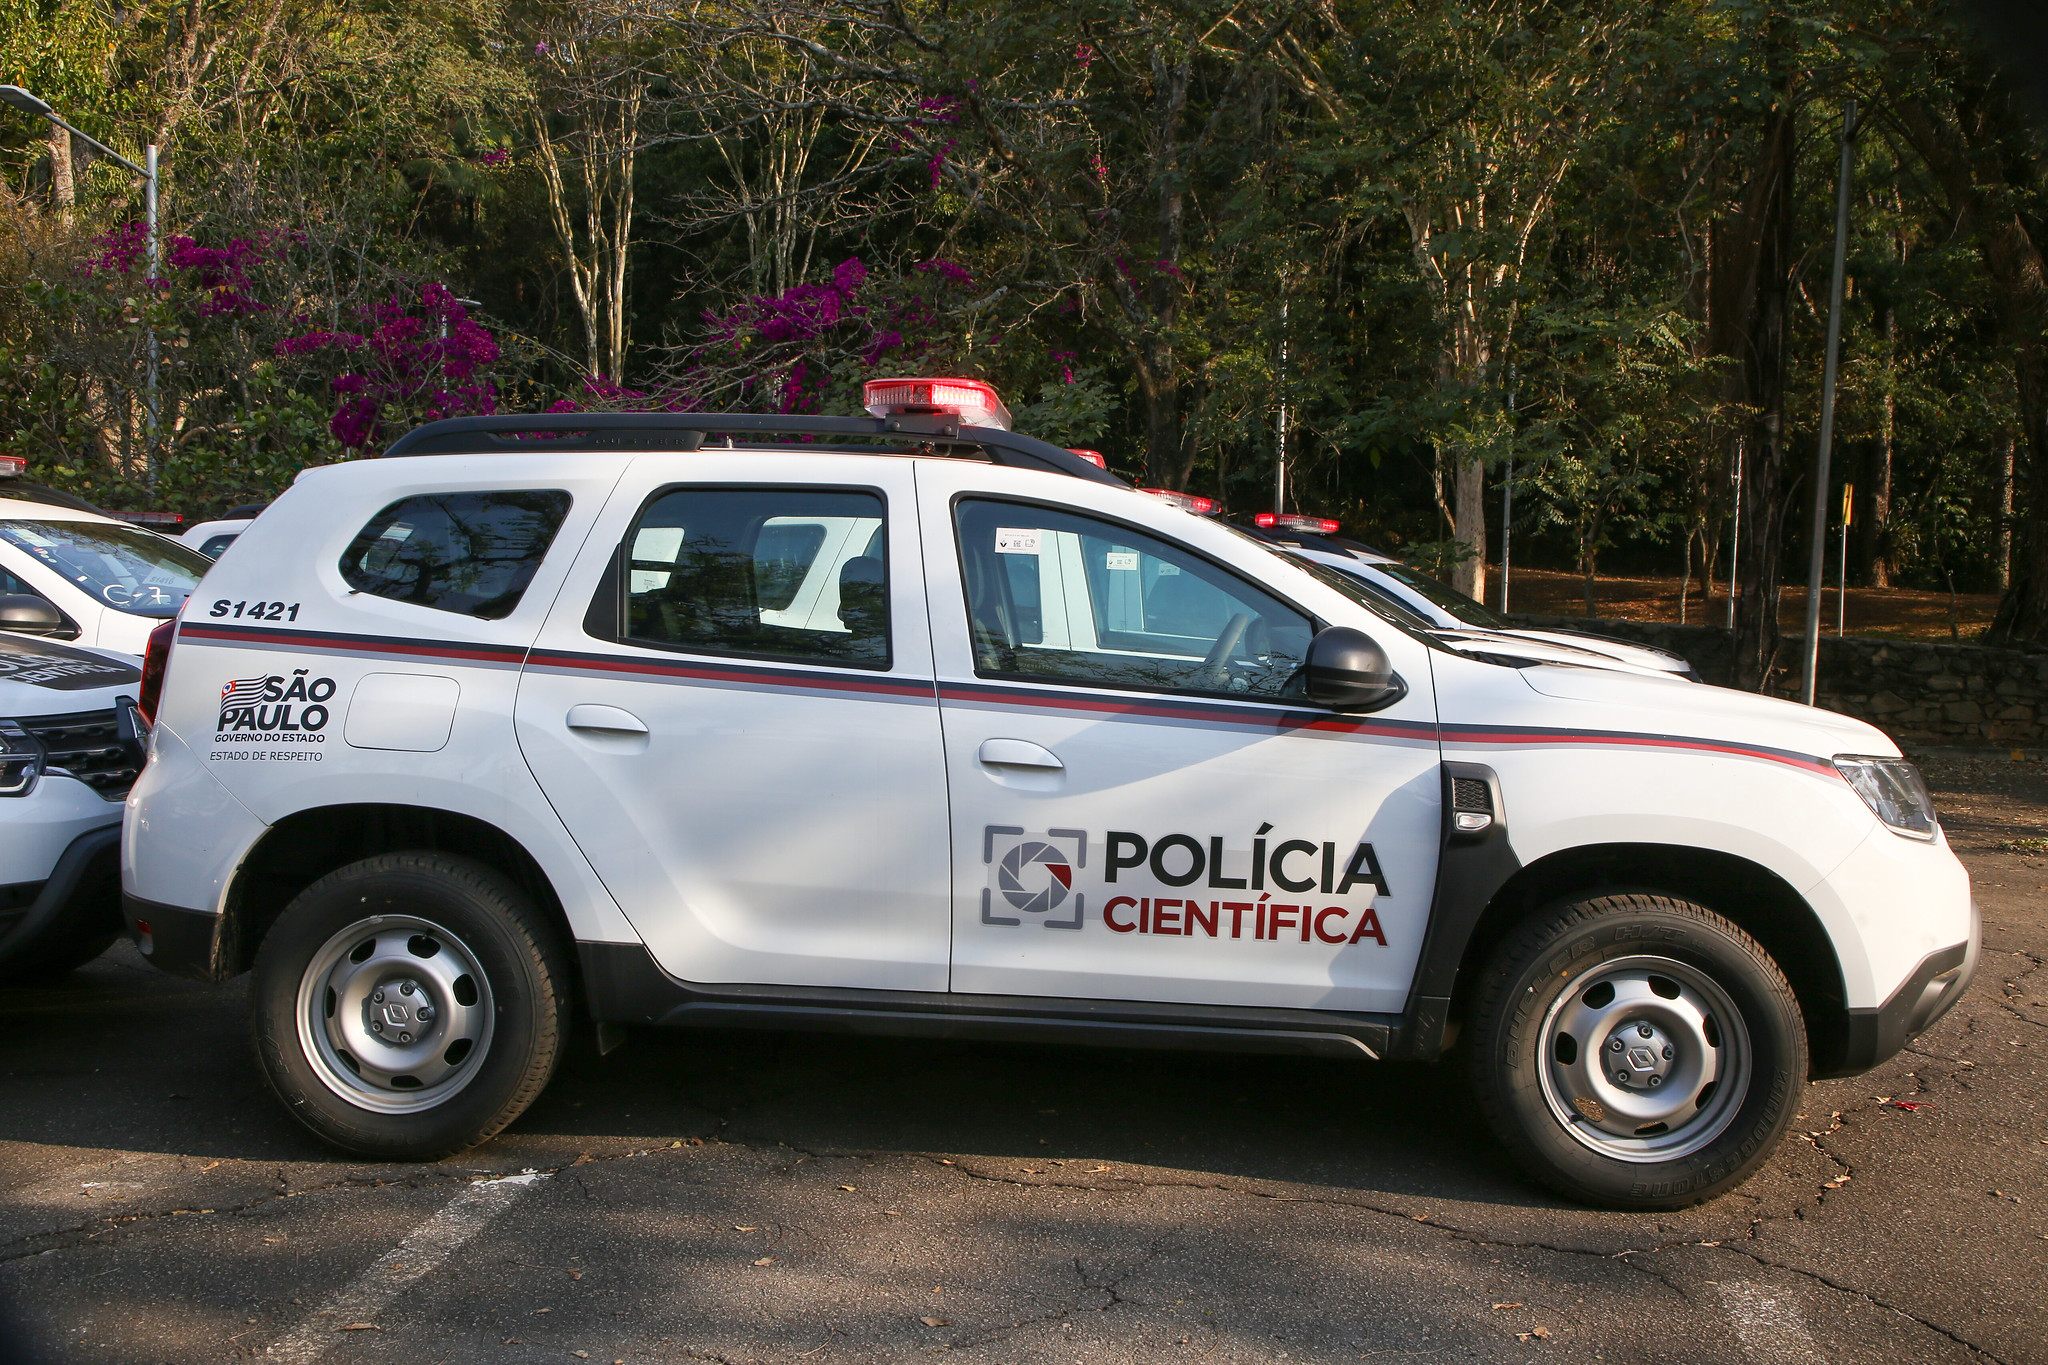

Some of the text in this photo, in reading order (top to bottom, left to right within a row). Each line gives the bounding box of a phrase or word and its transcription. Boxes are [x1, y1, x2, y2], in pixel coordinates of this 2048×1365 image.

[102, 584, 171, 605] C-7
[209, 599, 301, 622] S1421
[262, 668, 337, 703] SÃO
[216, 704, 329, 732] PAULO
[214, 733, 326, 743] GOVERNO DO ESTADO
[209, 751, 323, 762] ESTADO DE RESPEITO
[1104, 821, 1392, 897] POLÍCIA
[1102, 892, 1389, 947] CIENTÍFICA
